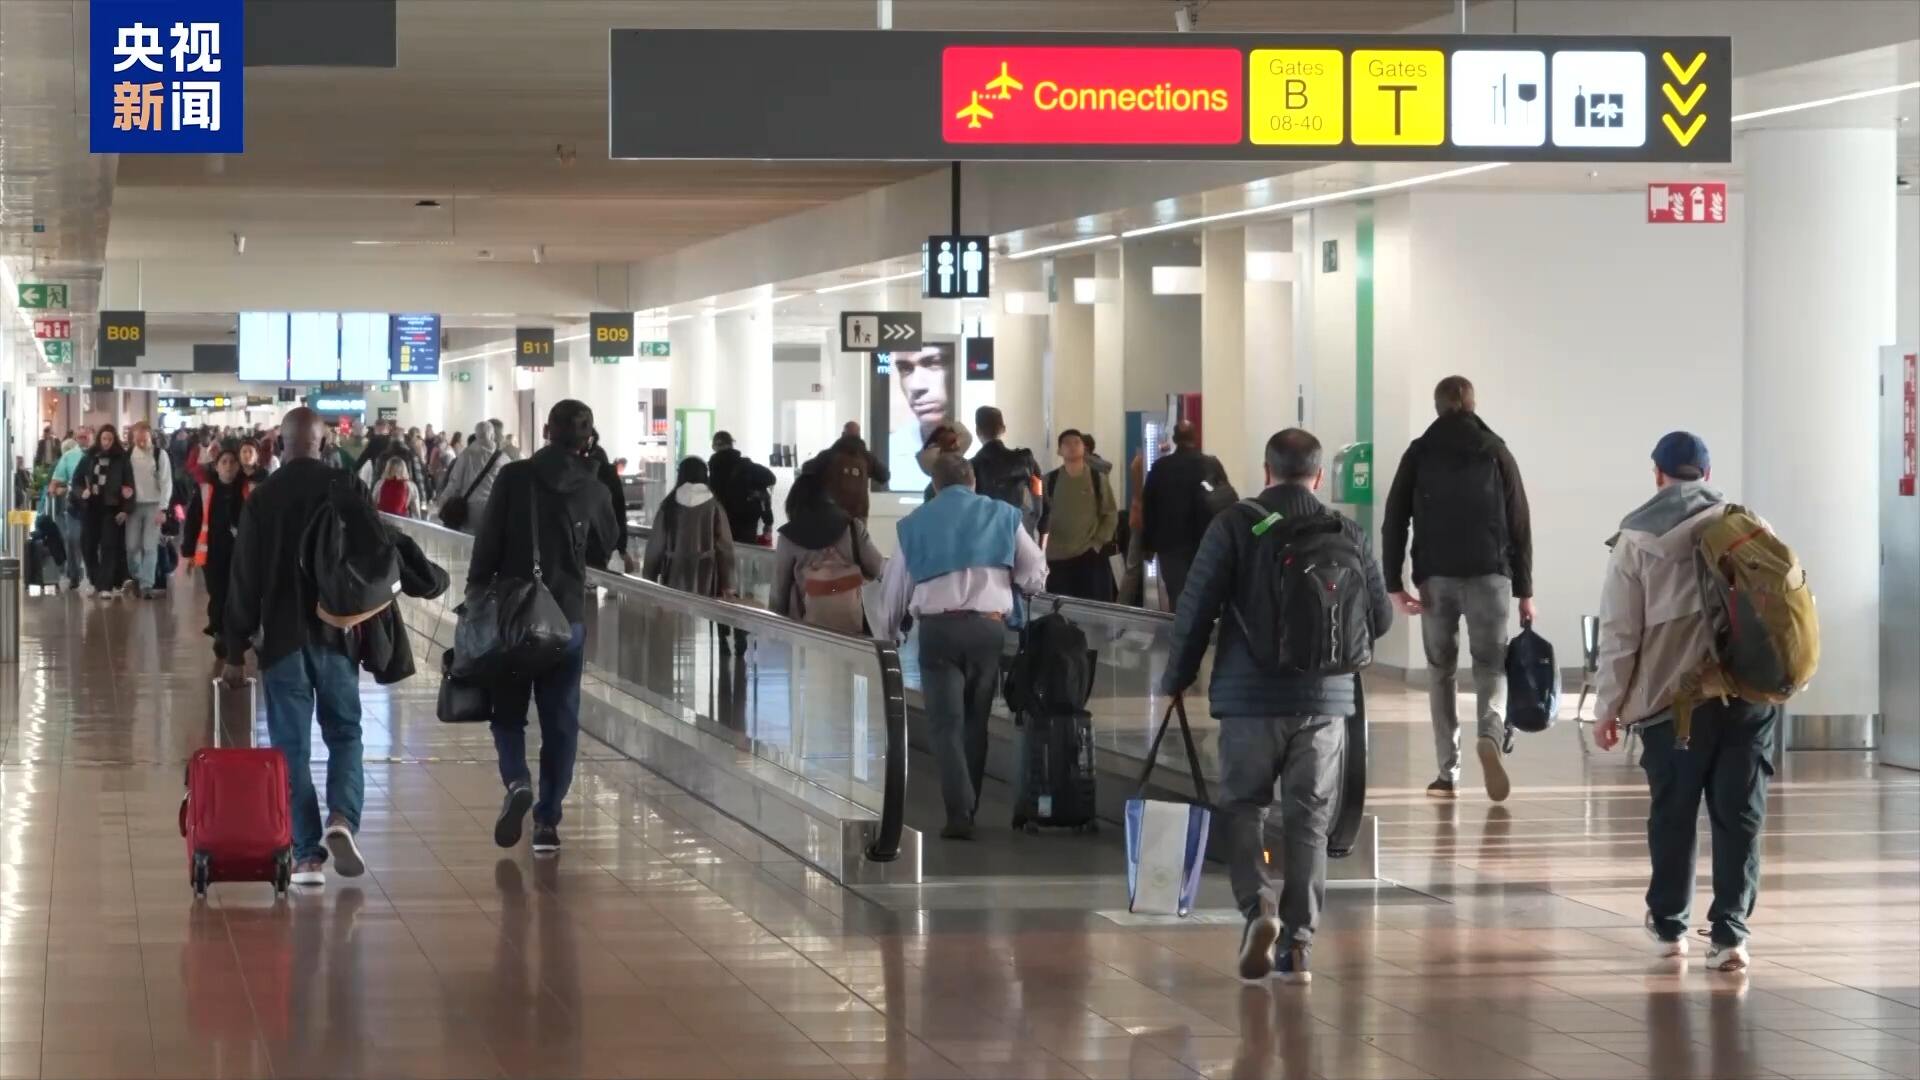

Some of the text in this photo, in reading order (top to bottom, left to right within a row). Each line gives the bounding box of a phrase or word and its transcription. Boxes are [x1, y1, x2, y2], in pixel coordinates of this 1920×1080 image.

[1268, 58, 1325, 76] Gates
[1367, 58, 1429, 78] Gates
[1033, 80, 1228, 111] Connections
[1285, 79, 1308, 110] B
[1378, 85, 1418, 136] T
[1269, 115, 1324, 132] 08-40
[107, 325, 140, 341] B08
[596, 327, 630, 342] B09
[522, 341, 550, 354] B11
